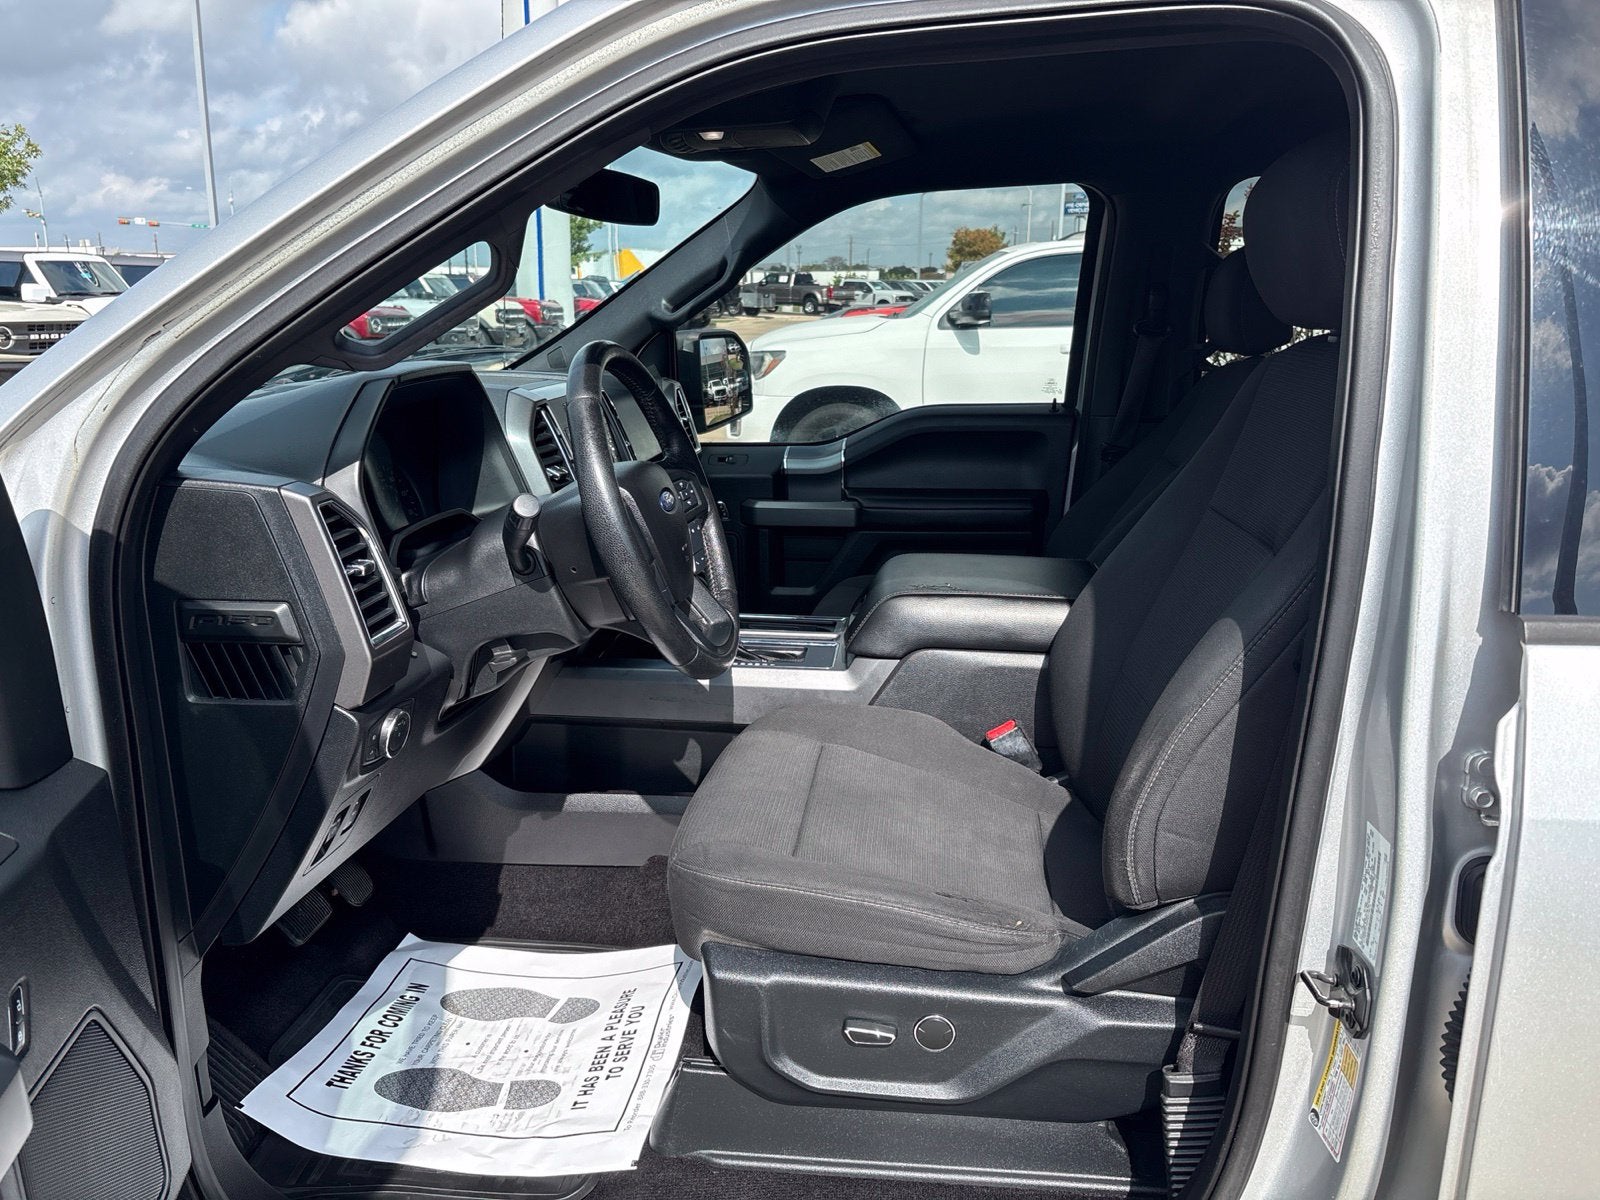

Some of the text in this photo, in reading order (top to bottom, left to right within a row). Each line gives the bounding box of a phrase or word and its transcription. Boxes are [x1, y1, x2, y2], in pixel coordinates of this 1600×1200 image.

[325, 982, 431, 1090] THANKS FOR COMING IN
[571, 987, 638, 1110] IT HAS BEEN A PLEASURE
[605, 1005, 645, 1081] TO SERVE YOU
